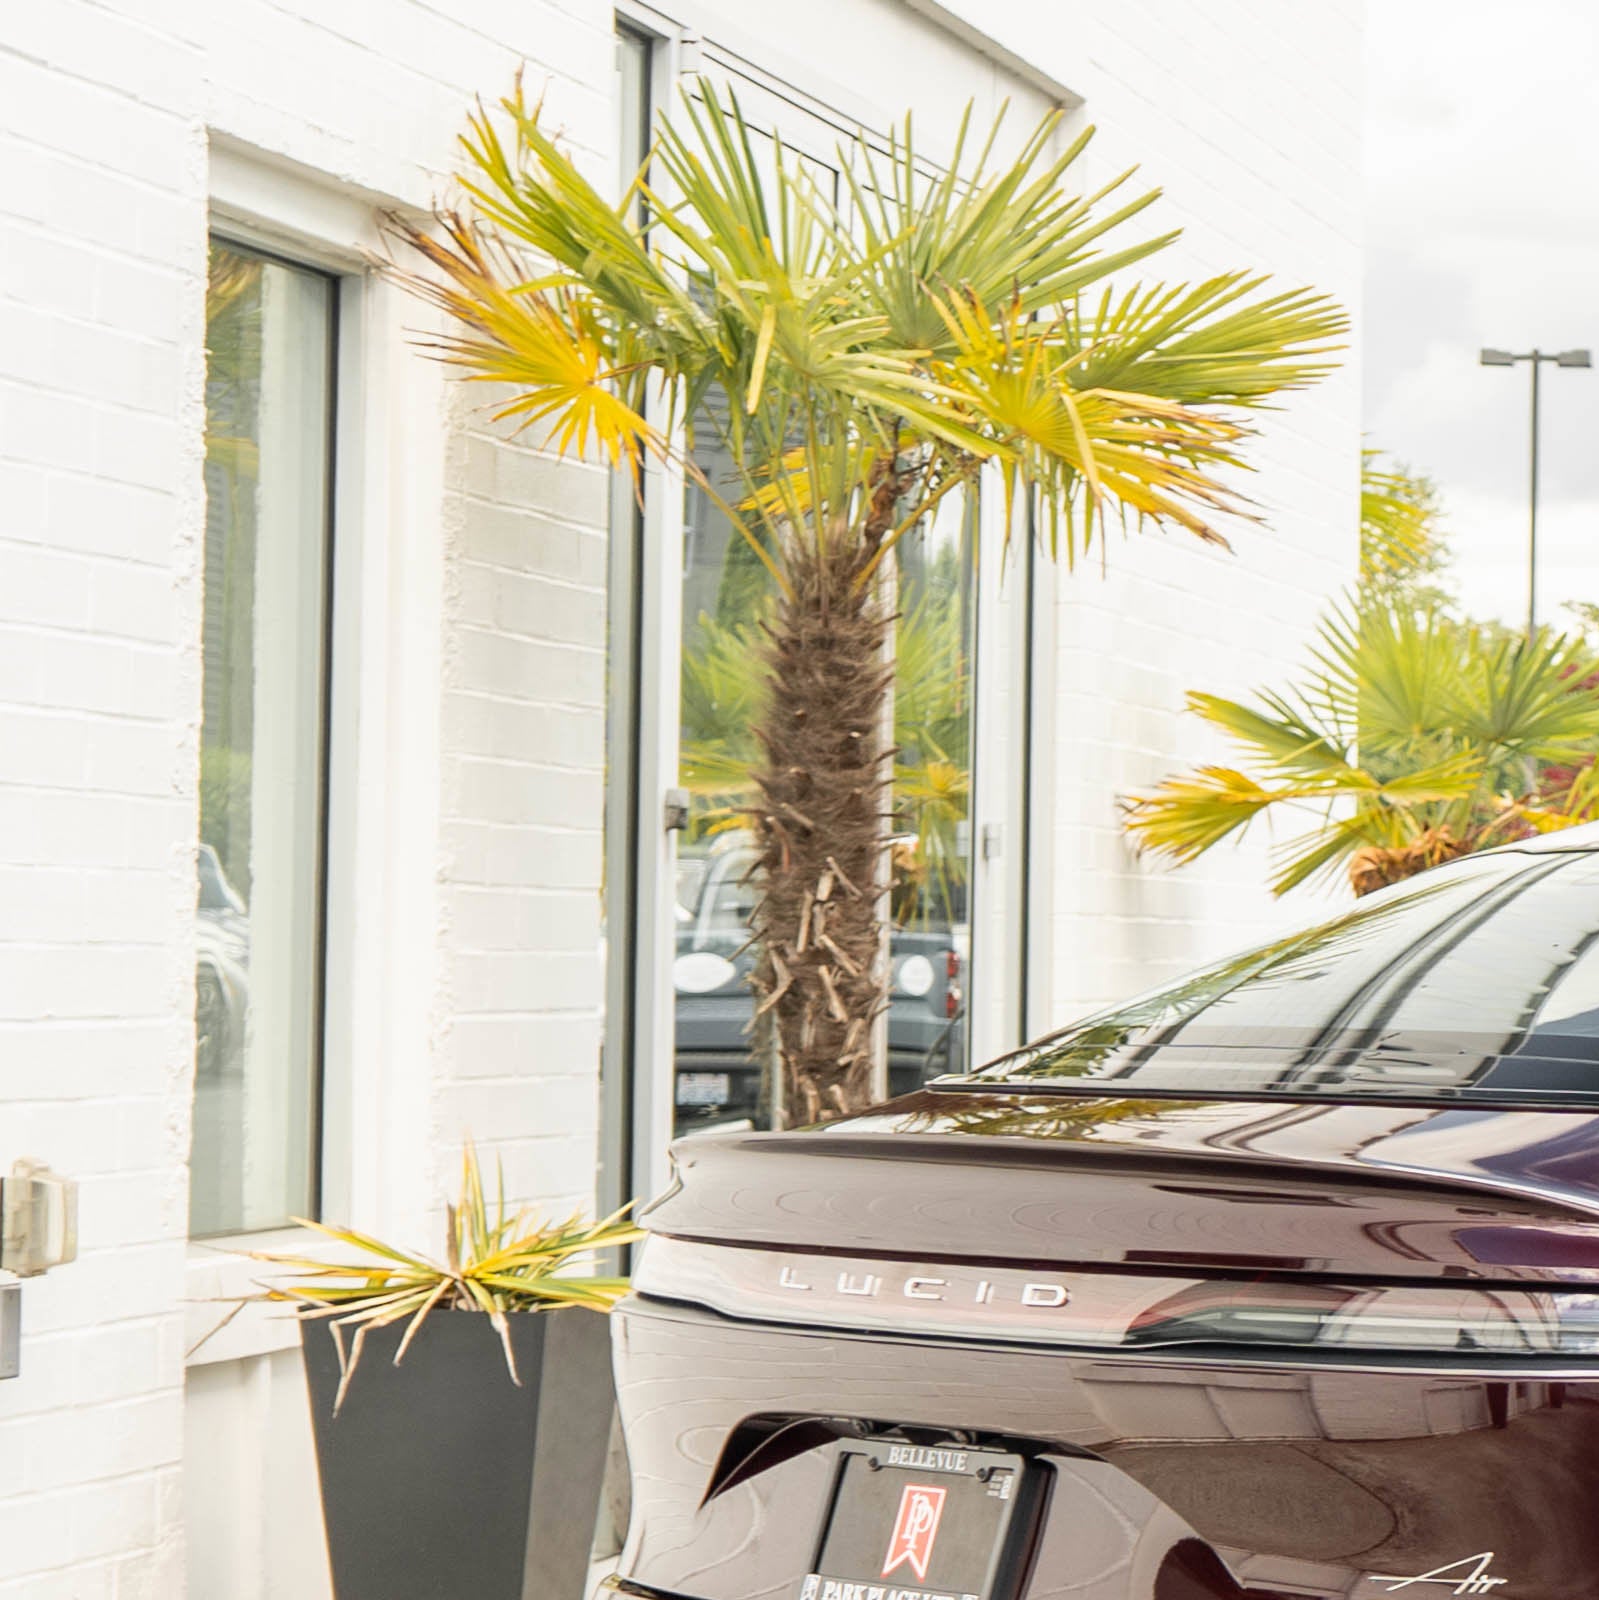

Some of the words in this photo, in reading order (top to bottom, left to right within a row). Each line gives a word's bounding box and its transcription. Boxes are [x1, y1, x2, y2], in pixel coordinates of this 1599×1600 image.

[779, 1265, 1069, 1308] LUCID
[888, 1446, 969, 1471] BELLEVUE
[1368, 1551, 1508, 1595] Air
